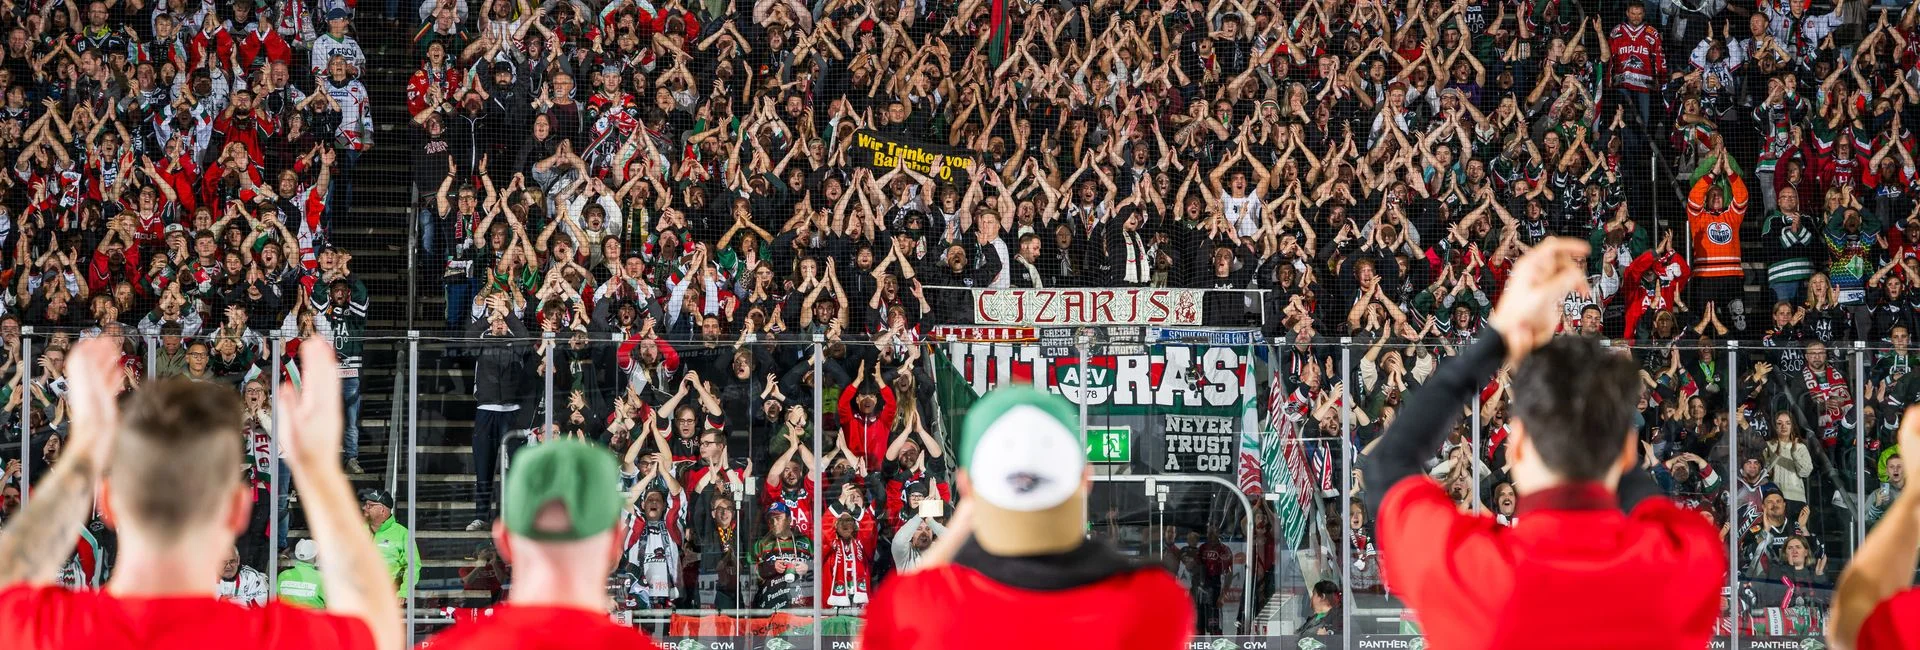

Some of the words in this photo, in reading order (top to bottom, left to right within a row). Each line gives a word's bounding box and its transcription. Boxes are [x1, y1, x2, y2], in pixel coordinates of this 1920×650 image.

[858, 133, 883, 151] Wir
[1043, 328, 1071, 338] GREEN
[1107, 326, 1140, 336] ULTRAS
[1041, 337, 1074, 347] GHETTO
[1046, 347, 1070, 356] CLUB
[1074, 389, 1098, 399] 178
[1165, 435, 1233, 454] TRUST
[1164, 455, 1180, 471] A
[1197, 455, 1232, 472] COP
[710, 642, 735, 650] GYM
[1243, 641, 1267, 650] GYM
[1359, 641, 1408, 649] PANTHER
[1751, 640, 1799, 649] PANTHER
